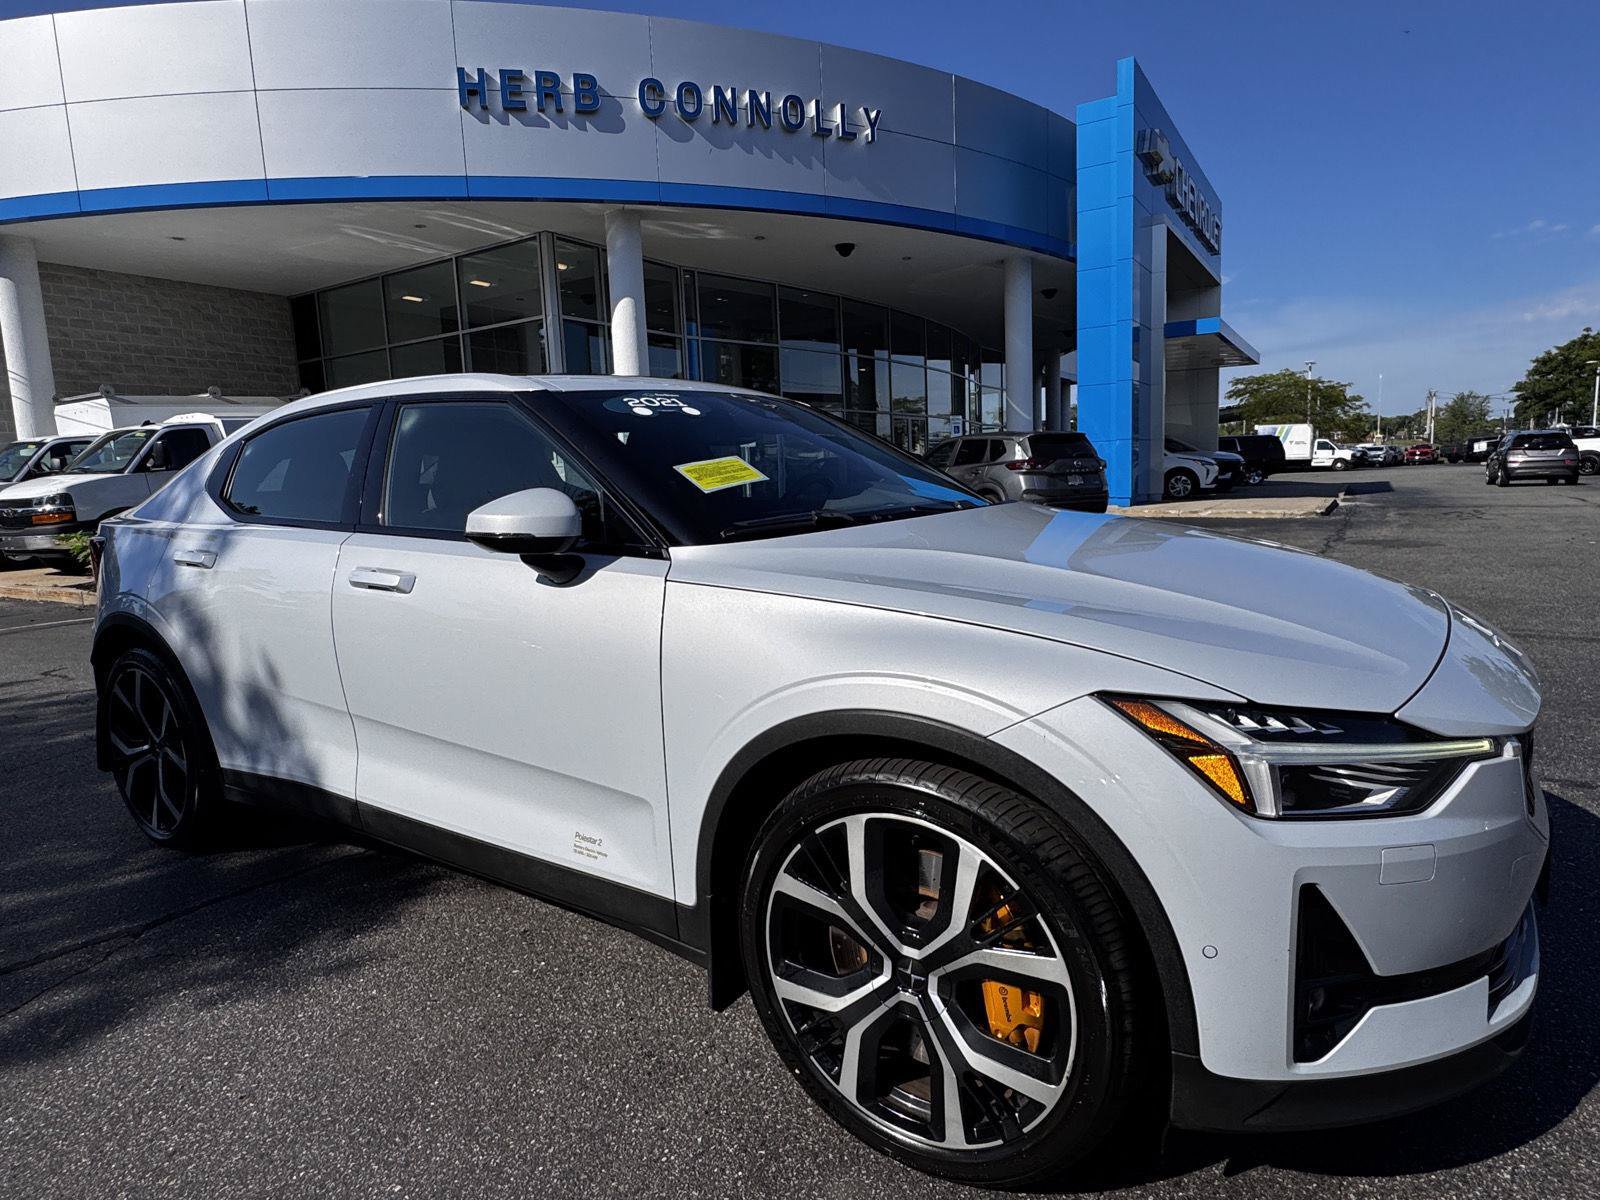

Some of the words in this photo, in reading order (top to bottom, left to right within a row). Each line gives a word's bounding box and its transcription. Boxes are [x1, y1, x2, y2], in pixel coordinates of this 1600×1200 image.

[457, 67, 601, 114] HERB
[638, 77, 882, 143] CONNOLLY
[623, 397, 688, 407] 2021
[575, 831, 597, 844] Polestar
[597, 838, 602, 846] 2
